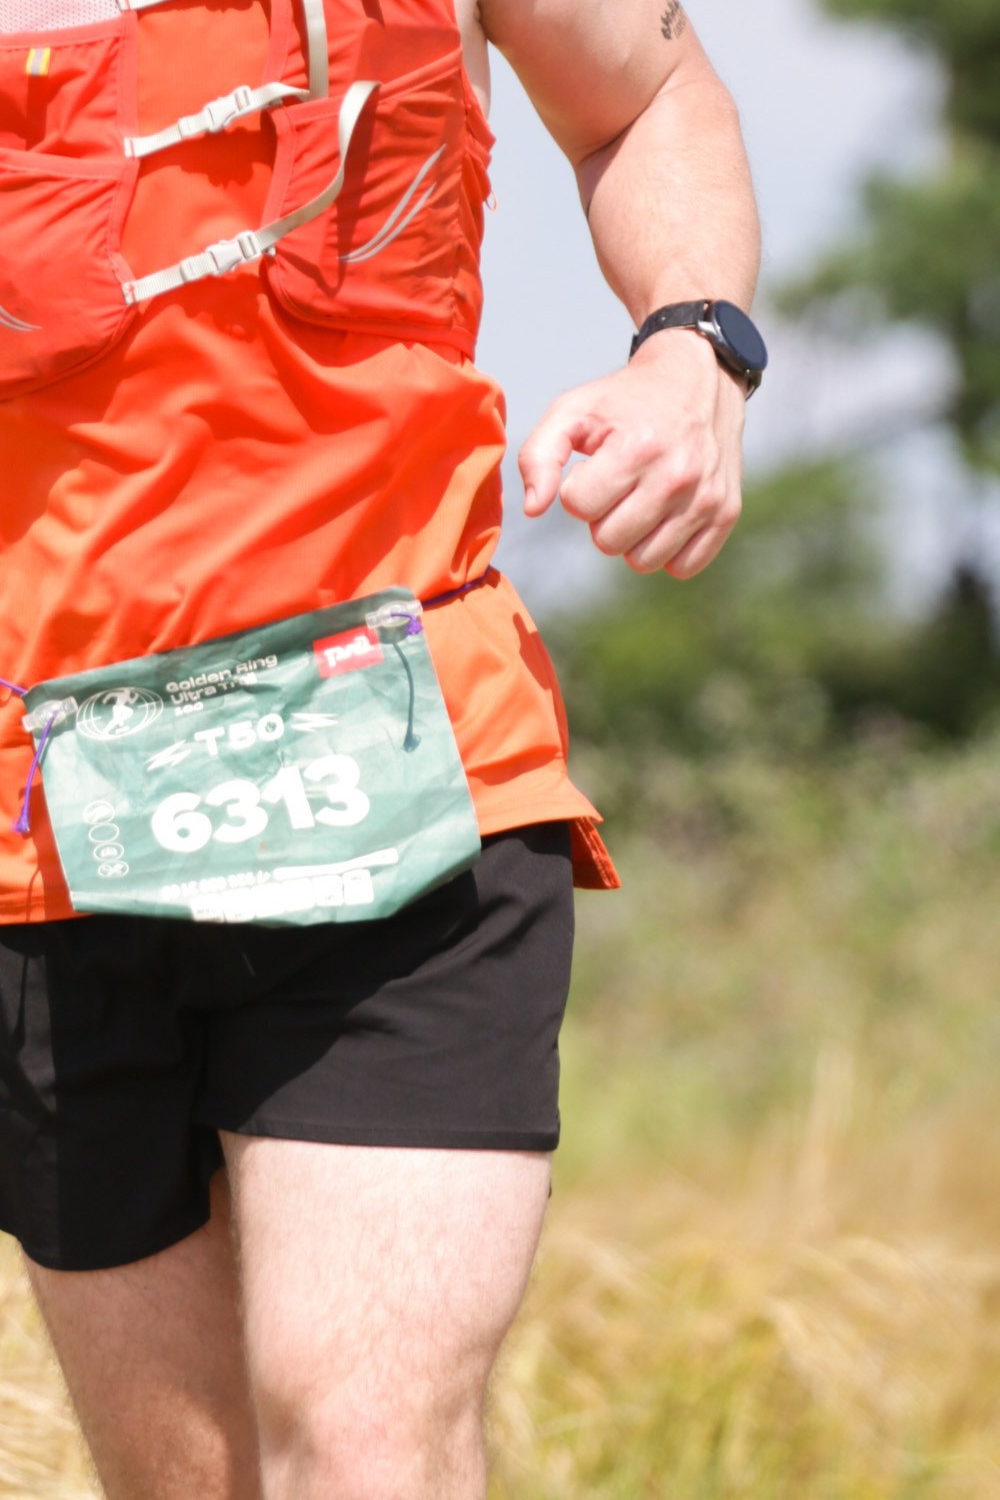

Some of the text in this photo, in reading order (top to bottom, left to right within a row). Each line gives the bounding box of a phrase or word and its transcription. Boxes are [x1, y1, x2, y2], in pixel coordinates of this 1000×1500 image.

[165, 654, 279, 693] Golden Ring
[170, 684, 218, 705] Ultra
[193, 712, 286, 757] T50
[150, 754, 371, 853] 6313
